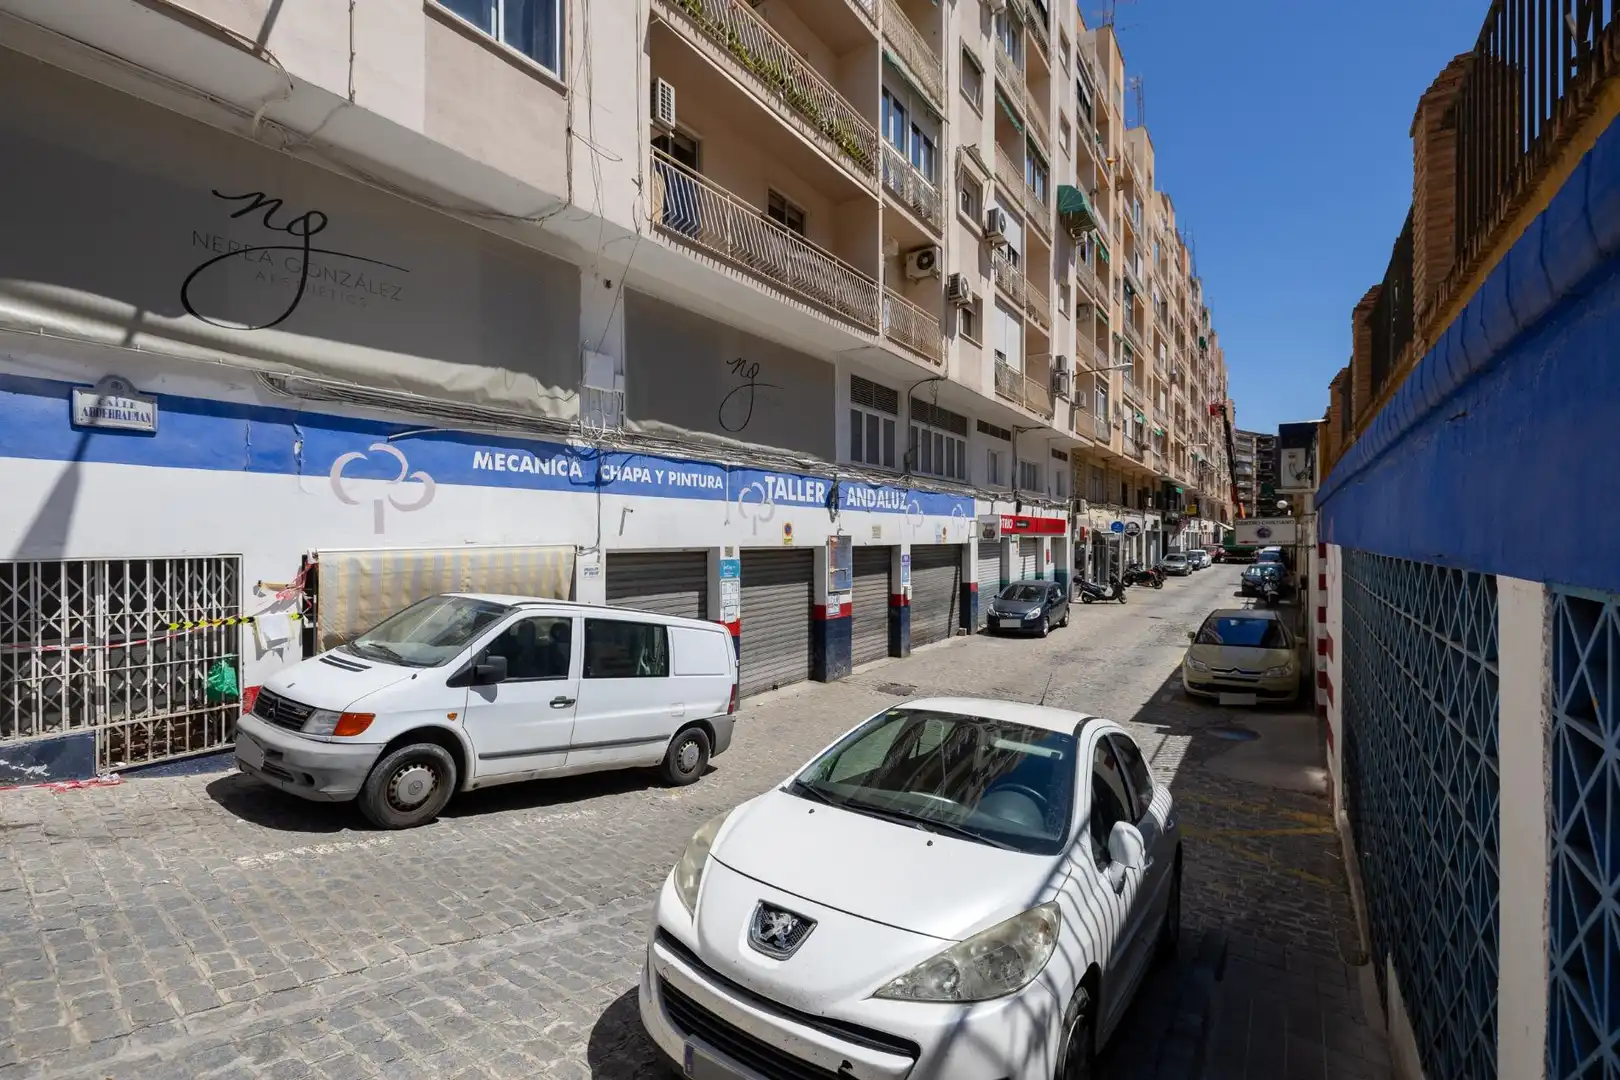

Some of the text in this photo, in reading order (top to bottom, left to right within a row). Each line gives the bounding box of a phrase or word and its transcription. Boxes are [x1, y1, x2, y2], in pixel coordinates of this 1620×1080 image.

[191, 229, 403, 301] NEREA GONZÁLEZ
[472, 451, 724, 490] MECANICA CHAPA Y PINTURA
[764, 475, 908, 511] TALLER ANDALUZ
